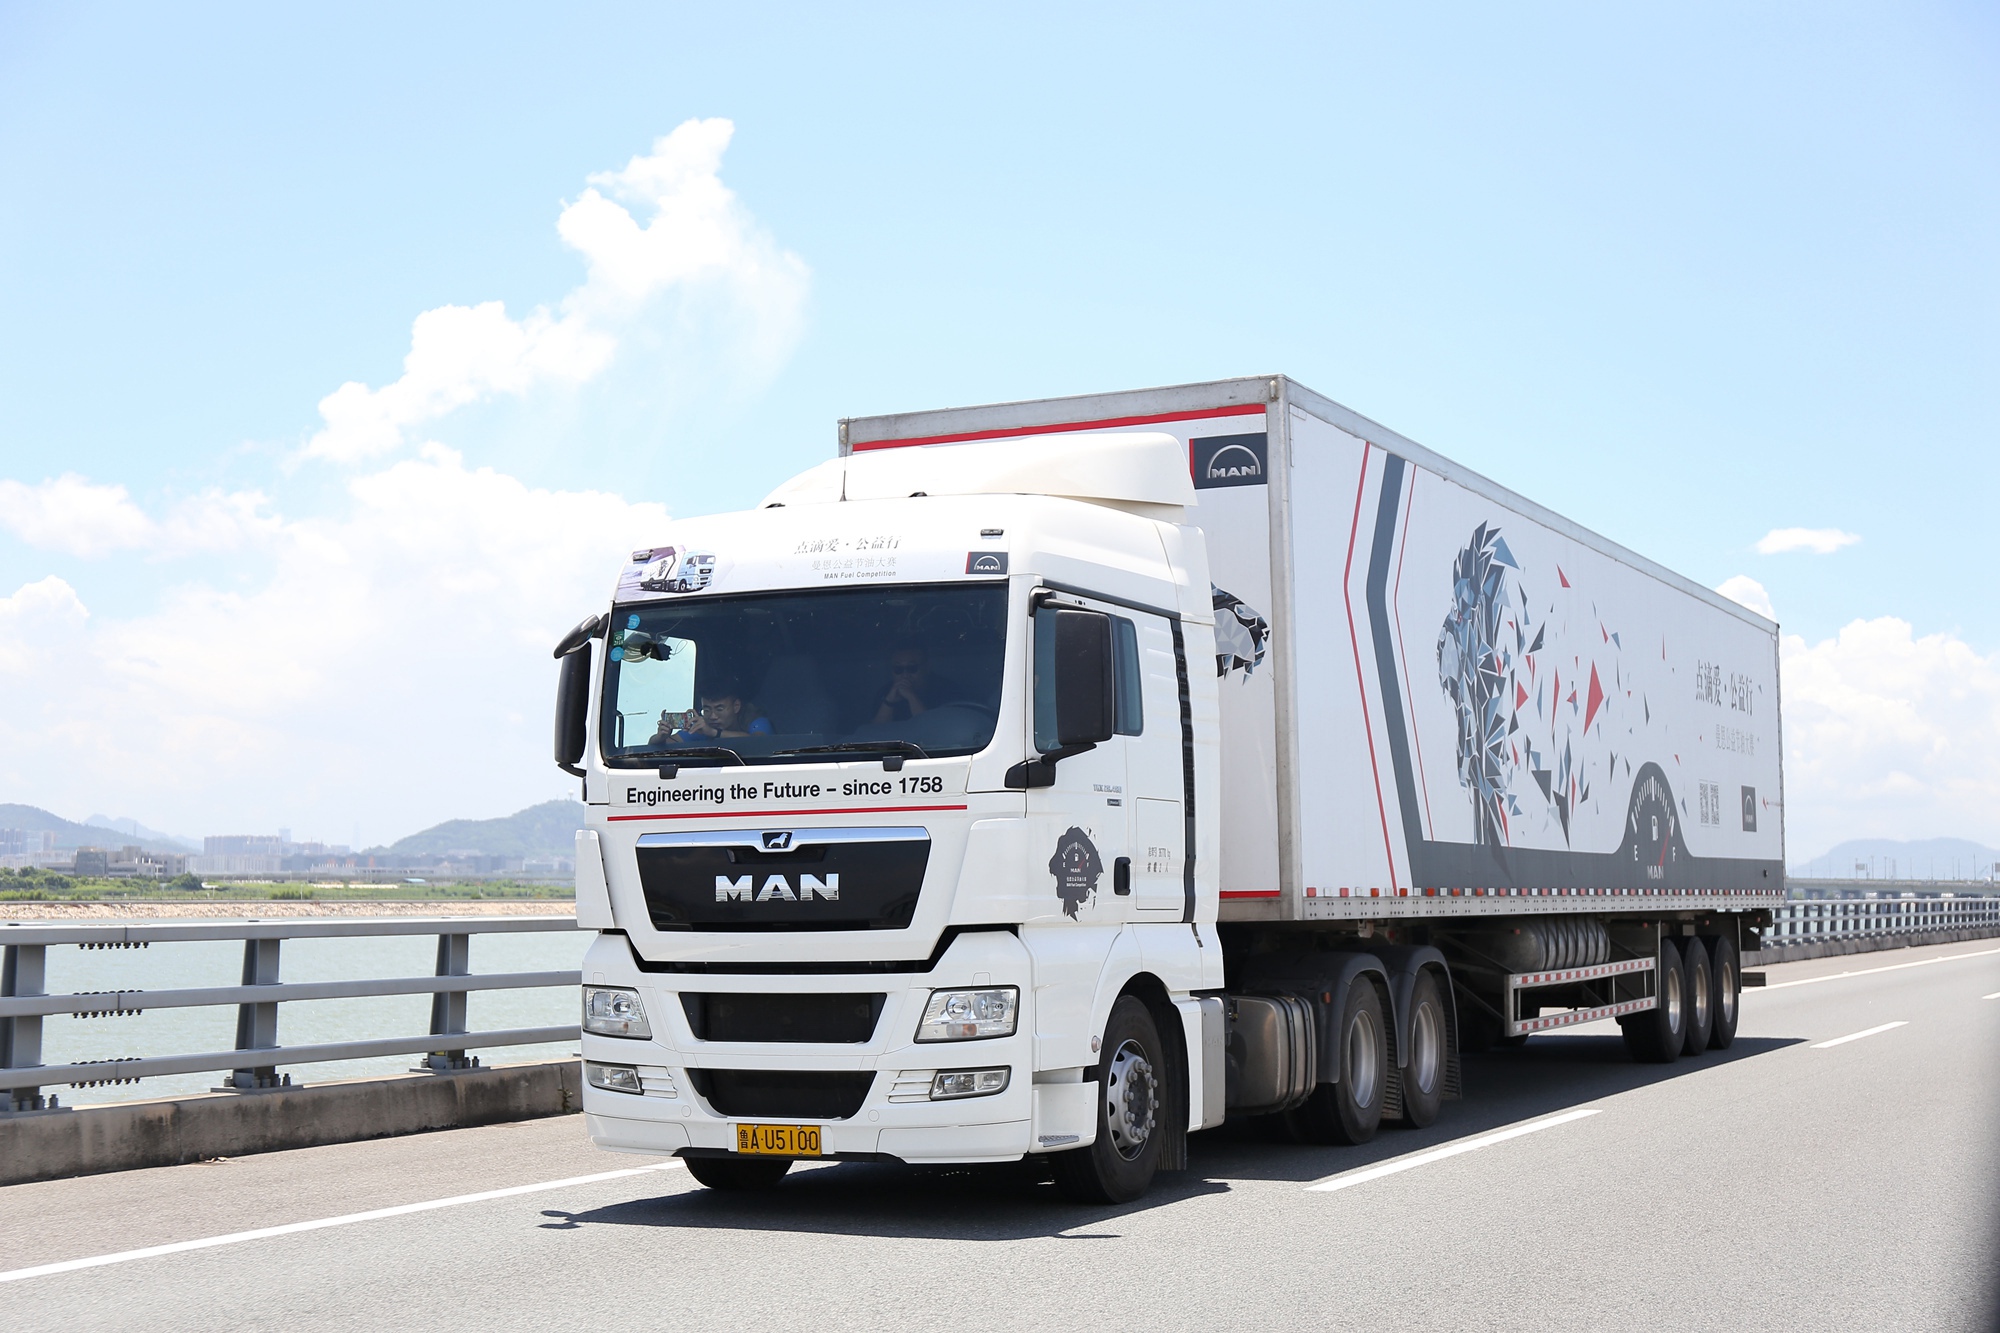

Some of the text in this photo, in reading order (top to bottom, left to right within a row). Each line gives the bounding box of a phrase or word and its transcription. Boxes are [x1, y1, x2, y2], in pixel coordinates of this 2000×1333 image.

[1211, 465, 1256, 478] MAN
[856, 570, 896, 578] Competition
[627, 785, 724, 806] Engineering
[730, 783, 757, 799] the
[763, 781, 820, 798] Future
[842, 779, 892, 796] since
[898, 776, 943, 793] 1758
[1634, 844, 1638, 861] E
[1672, 846, 1676, 862] F
[1647, 865, 1664, 880] MAN
[715, 873, 839, 902] MAN
